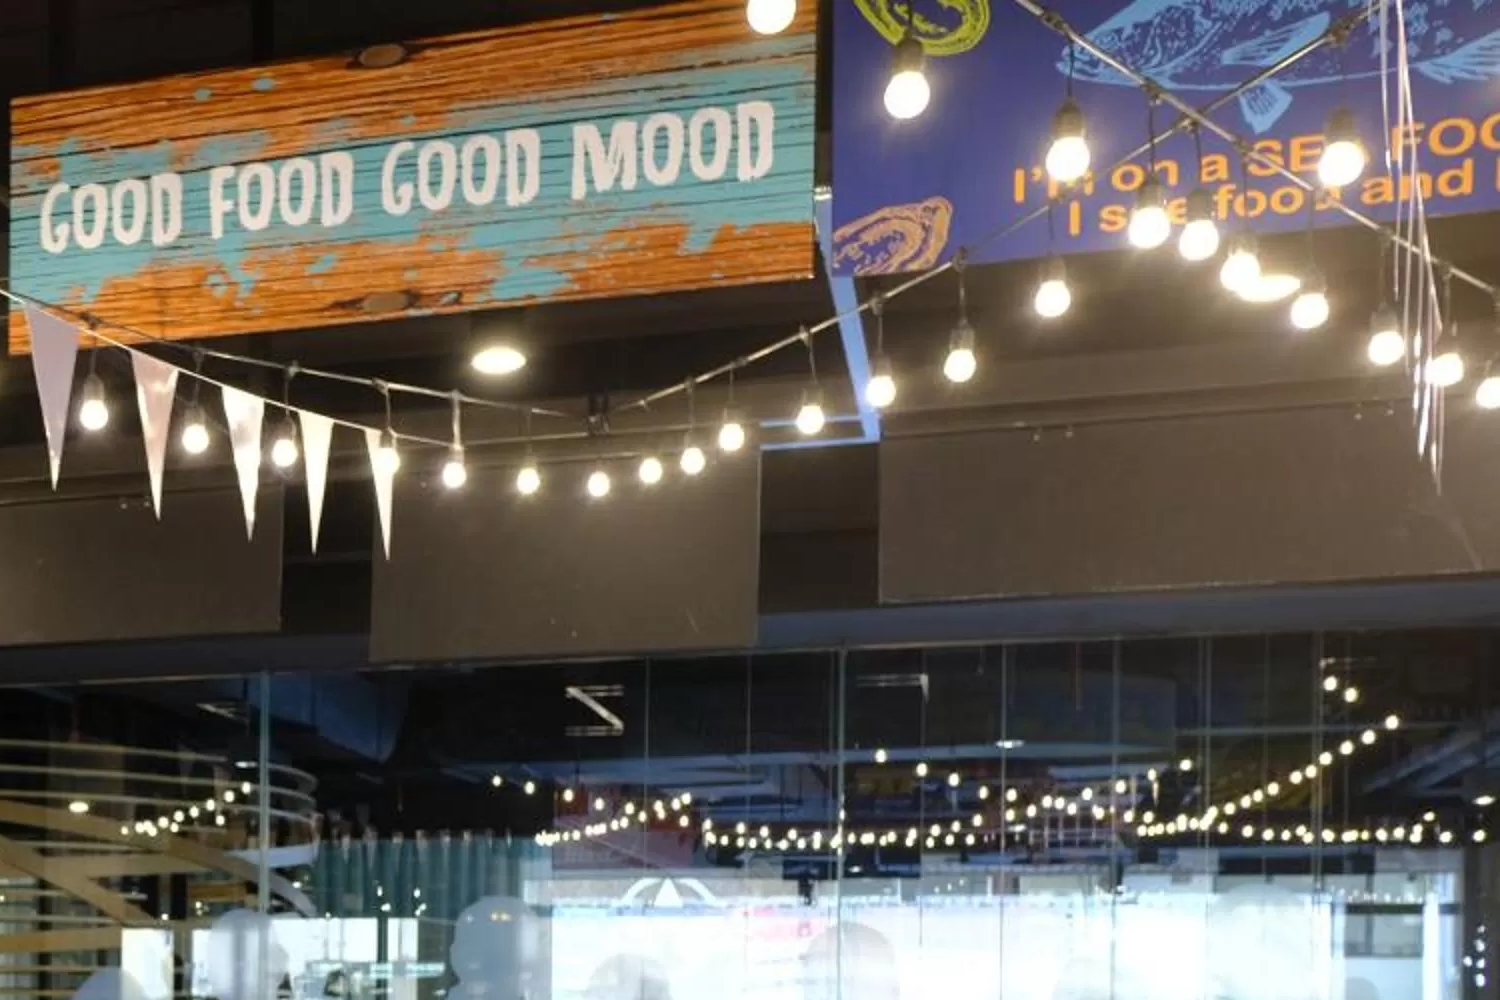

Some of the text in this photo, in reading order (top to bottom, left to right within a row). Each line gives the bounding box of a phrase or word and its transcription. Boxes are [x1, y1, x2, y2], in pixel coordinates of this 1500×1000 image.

[39, 101, 775, 256] GOOD FOOD GOOD MOOD
[1069, 201, 1080, 237] I
[1099, 197, 1187, 232] se
[1361, 158, 1473, 205] and
[1111, 159, 1179, 192] on
[1201, 153, 1228, 183] a
[1248, 135, 1368, 177] SE
